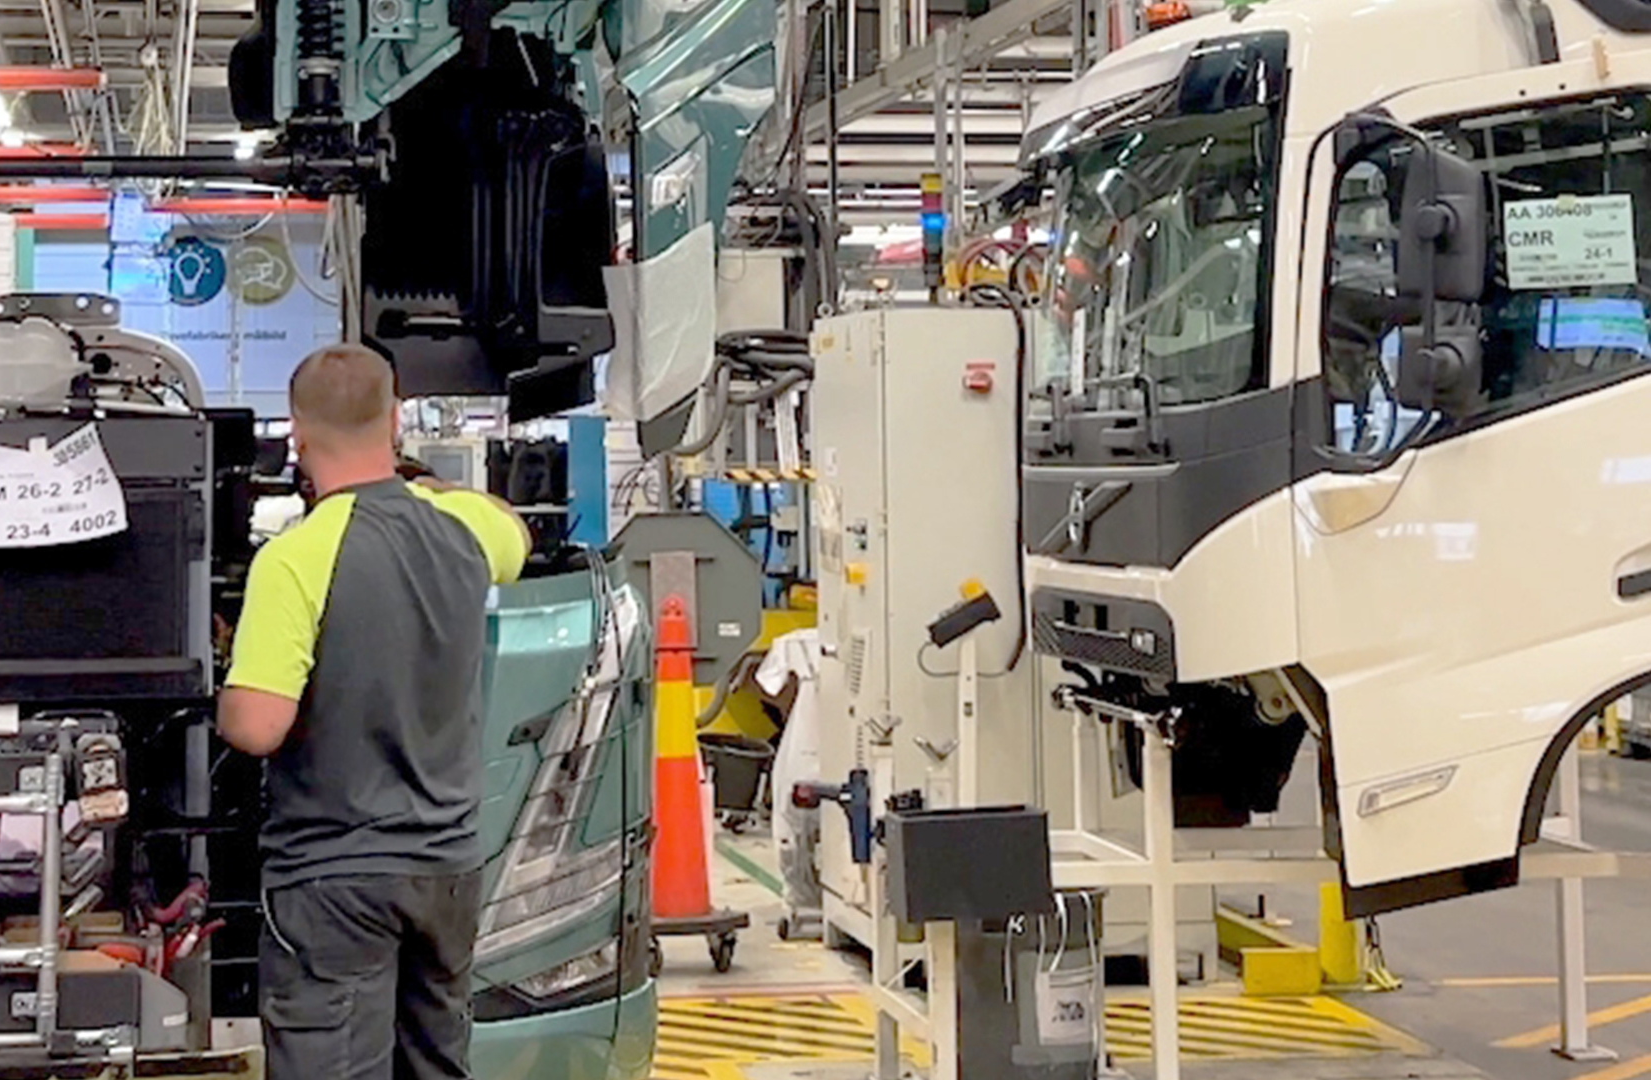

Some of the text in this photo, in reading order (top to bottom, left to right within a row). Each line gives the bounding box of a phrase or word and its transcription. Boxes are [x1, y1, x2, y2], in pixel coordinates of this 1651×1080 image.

[1507, 207, 1532, 219] AA
[1508, 230, 1554, 247] CMR
[1585, 248, 1613, 260] 24-1
[17, 483, 61, 500] 26-2
[6, 524, 52, 540] 23-4
[69, 510, 118, 534] 4002
